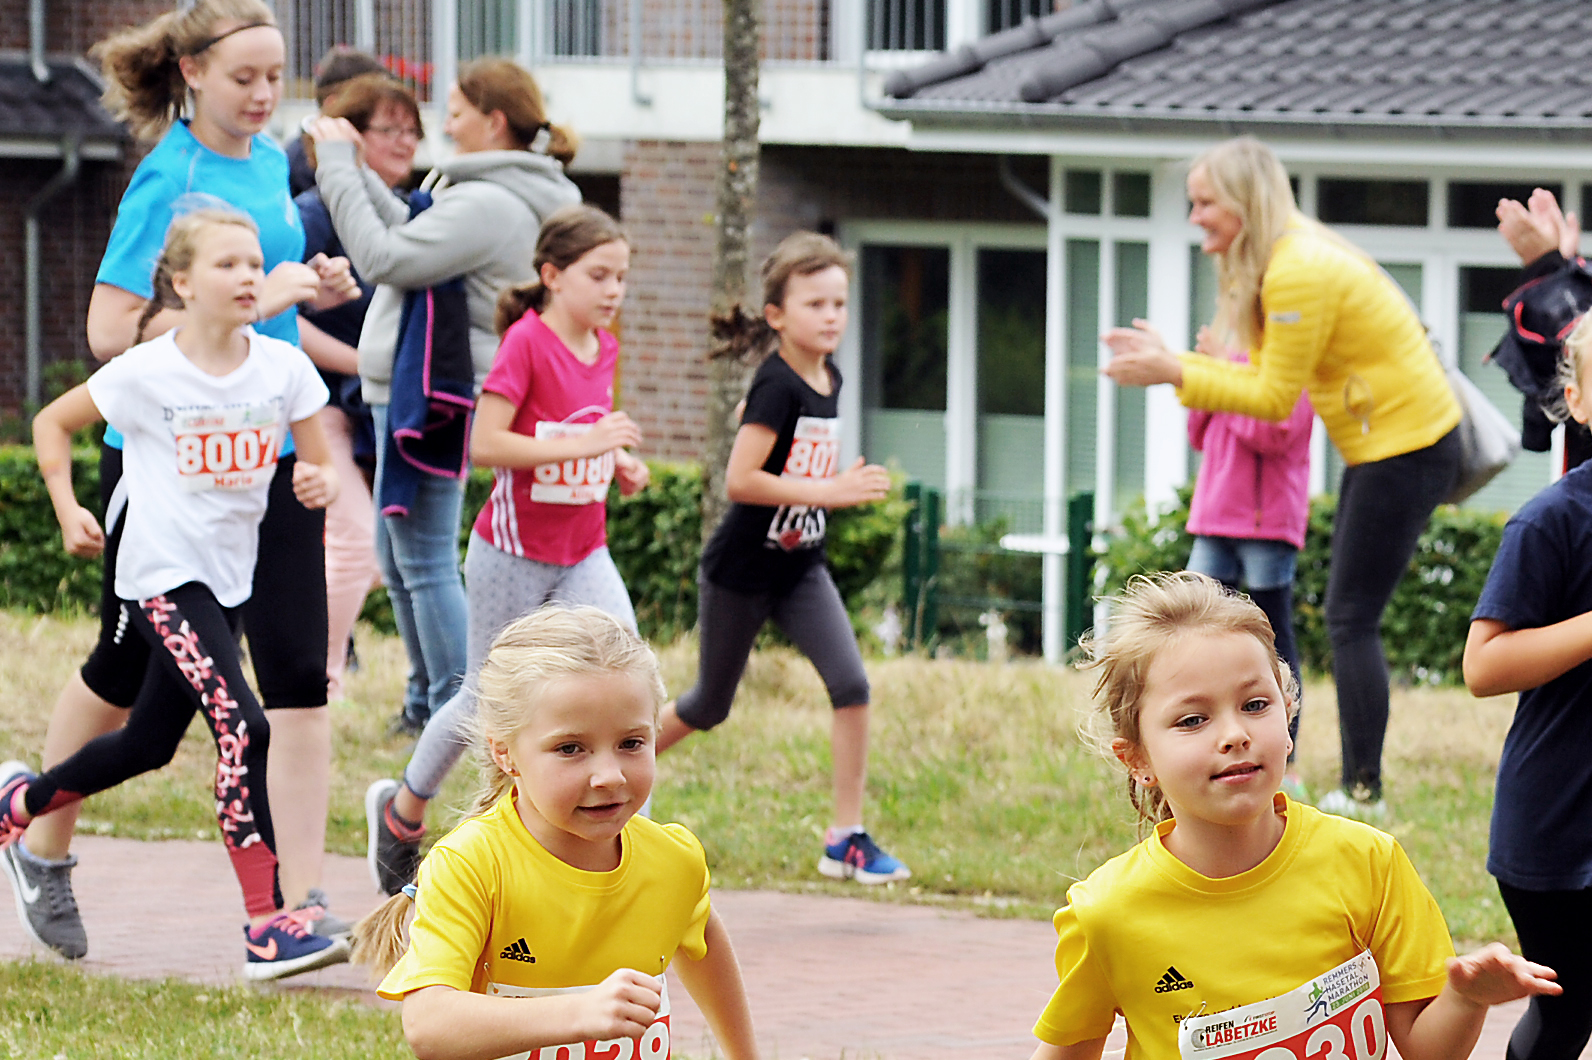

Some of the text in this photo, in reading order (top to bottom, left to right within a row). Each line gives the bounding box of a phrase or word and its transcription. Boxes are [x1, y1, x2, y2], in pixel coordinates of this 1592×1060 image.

[177, 427, 280, 475] 8007
[500, 951, 536, 964] adidas
[1322, 961, 1357, 985] REMMERS
[1325, 971, 1359, 993] HASETAL
[1154, 979, 1195, 994] adidas
[1328, 973, 1369, 1001] MARATHON
[1205, 1020, 1235, 1033] REIFEN
[1205, 1015, 1278, 1047] LABETZKE
